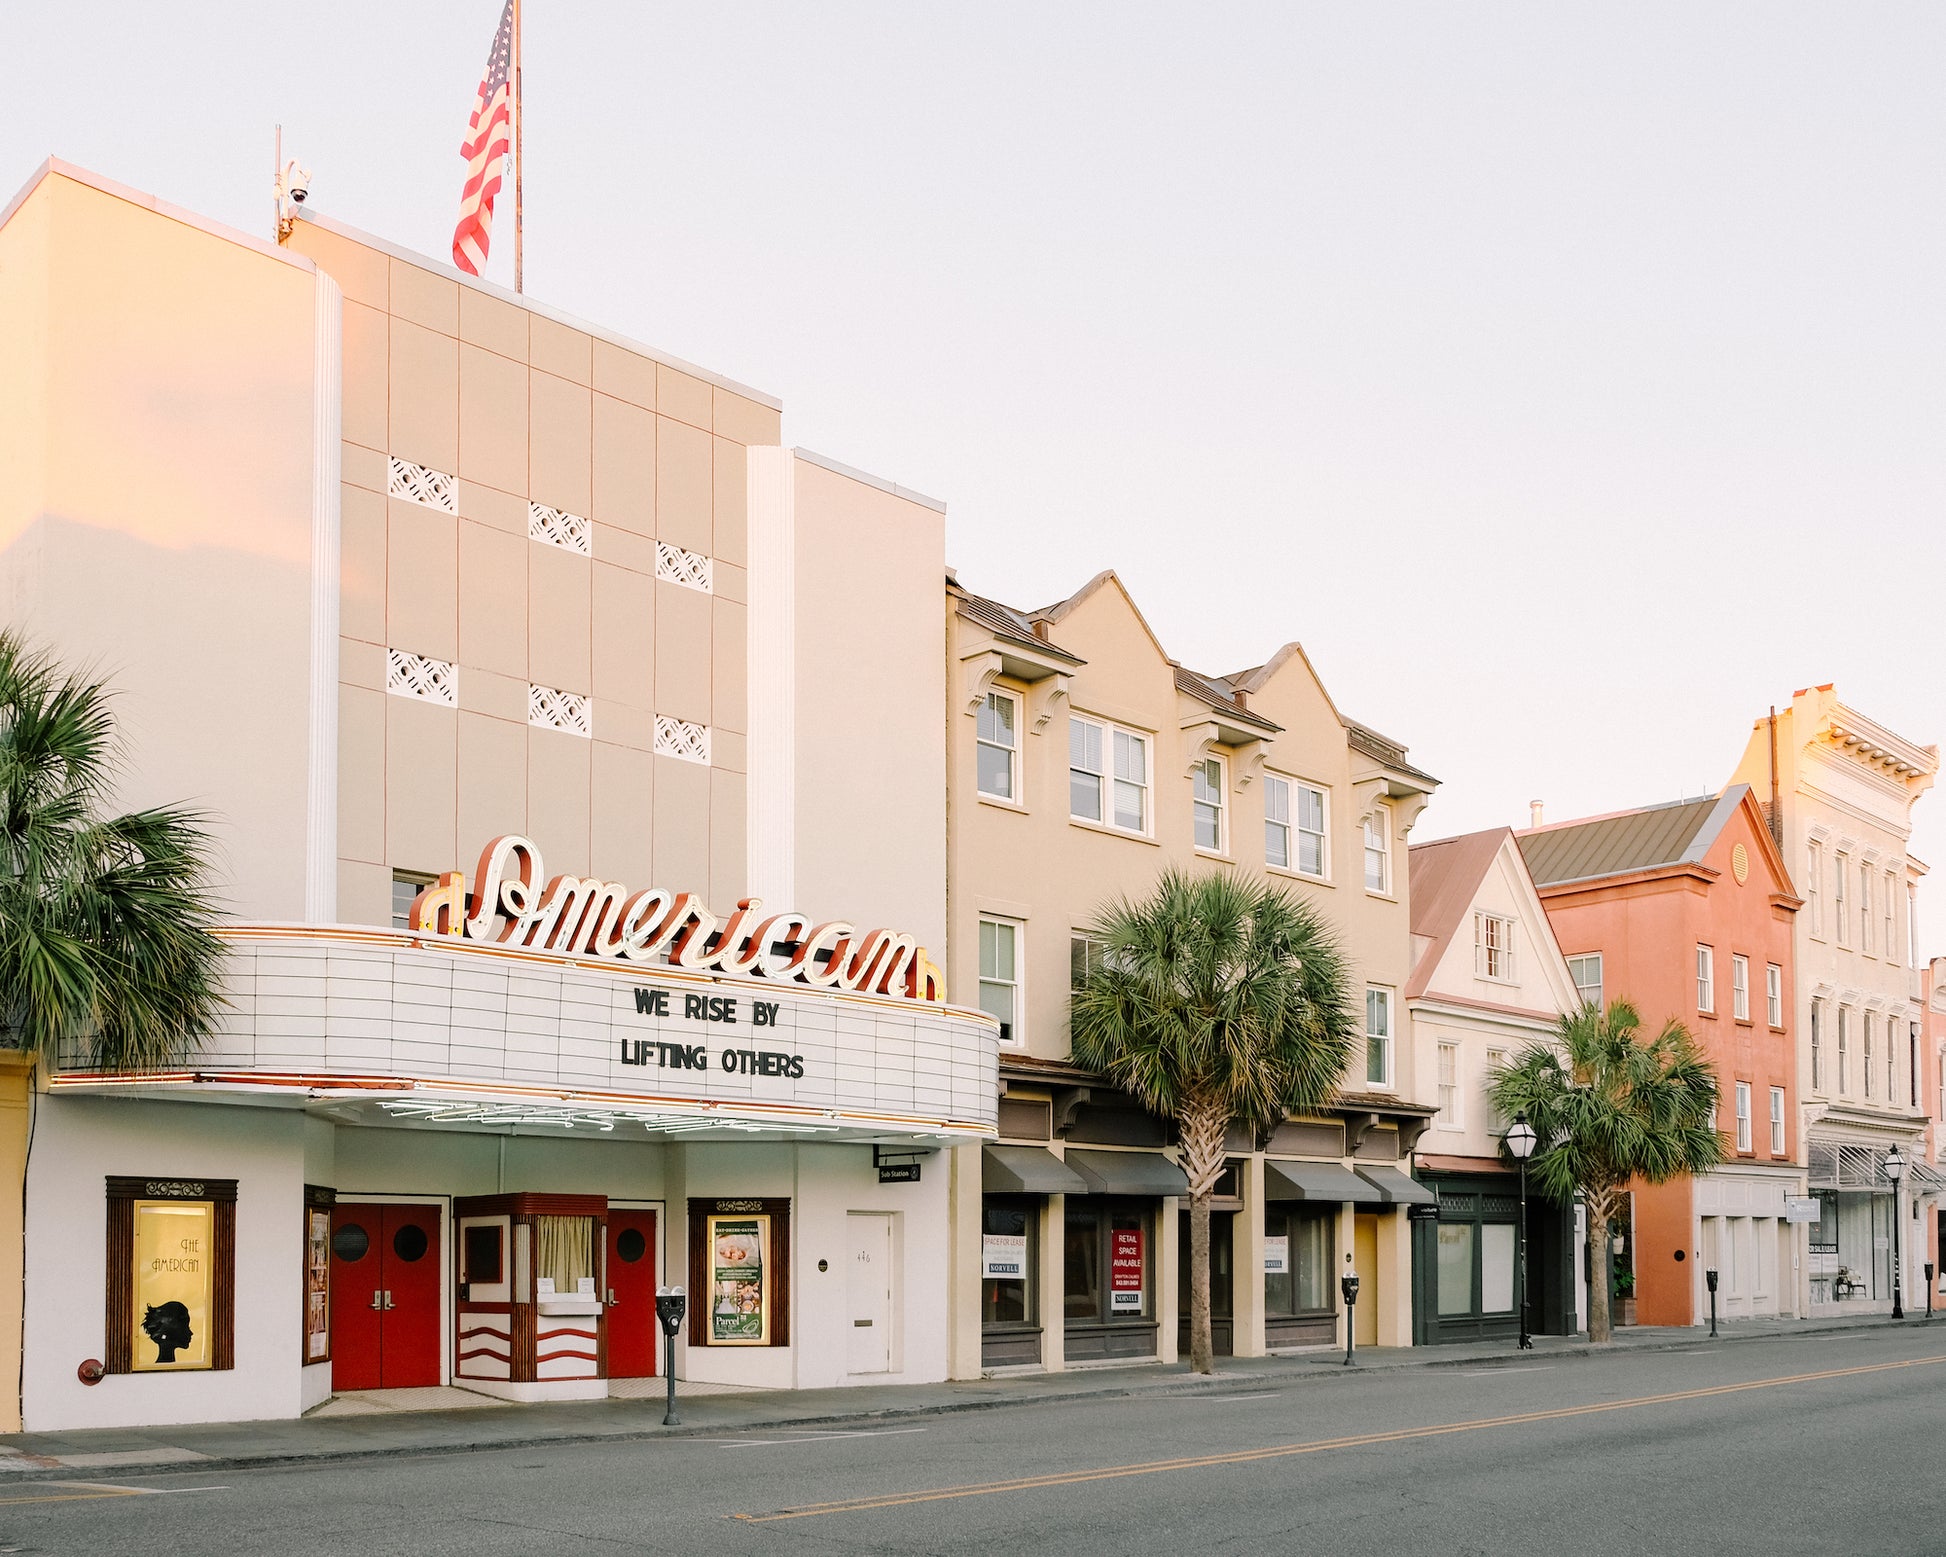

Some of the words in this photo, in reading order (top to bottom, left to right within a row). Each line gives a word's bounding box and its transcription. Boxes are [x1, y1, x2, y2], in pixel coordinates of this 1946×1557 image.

[466, 833, 917, 996] American
[634, 987, 670, 1017] WE
[685, 993, 737, 1024] RISE
[753, 1001, 780, 1027] BY
[621, 1038, 708, 1071] LIFTING
[721, 1048, 805, 1079] OTHERS
[891, 1169, 910, 1178] Station
[984, 1236, 1000, 1246] SPACE
[1000, 1237, 1010, 1246] FOR
[1010, 1237, 1025, 1247] LEASE
[1118, 1234, 1138, 1243] RETAIL
[180, 1238, 200, 1253] THE
[1118, 1247, 1137, 1255] SPACE
[152, 1257, 200, 1273] AMERICAN
[990, 1264, 1018, 1273] NORVELL
[1113, 1258, 1142, 1268] AVAILABLE
[1116, 1294, 1138, 1302] NORVELL
[716, 1315, 740, 1326] Parcel
